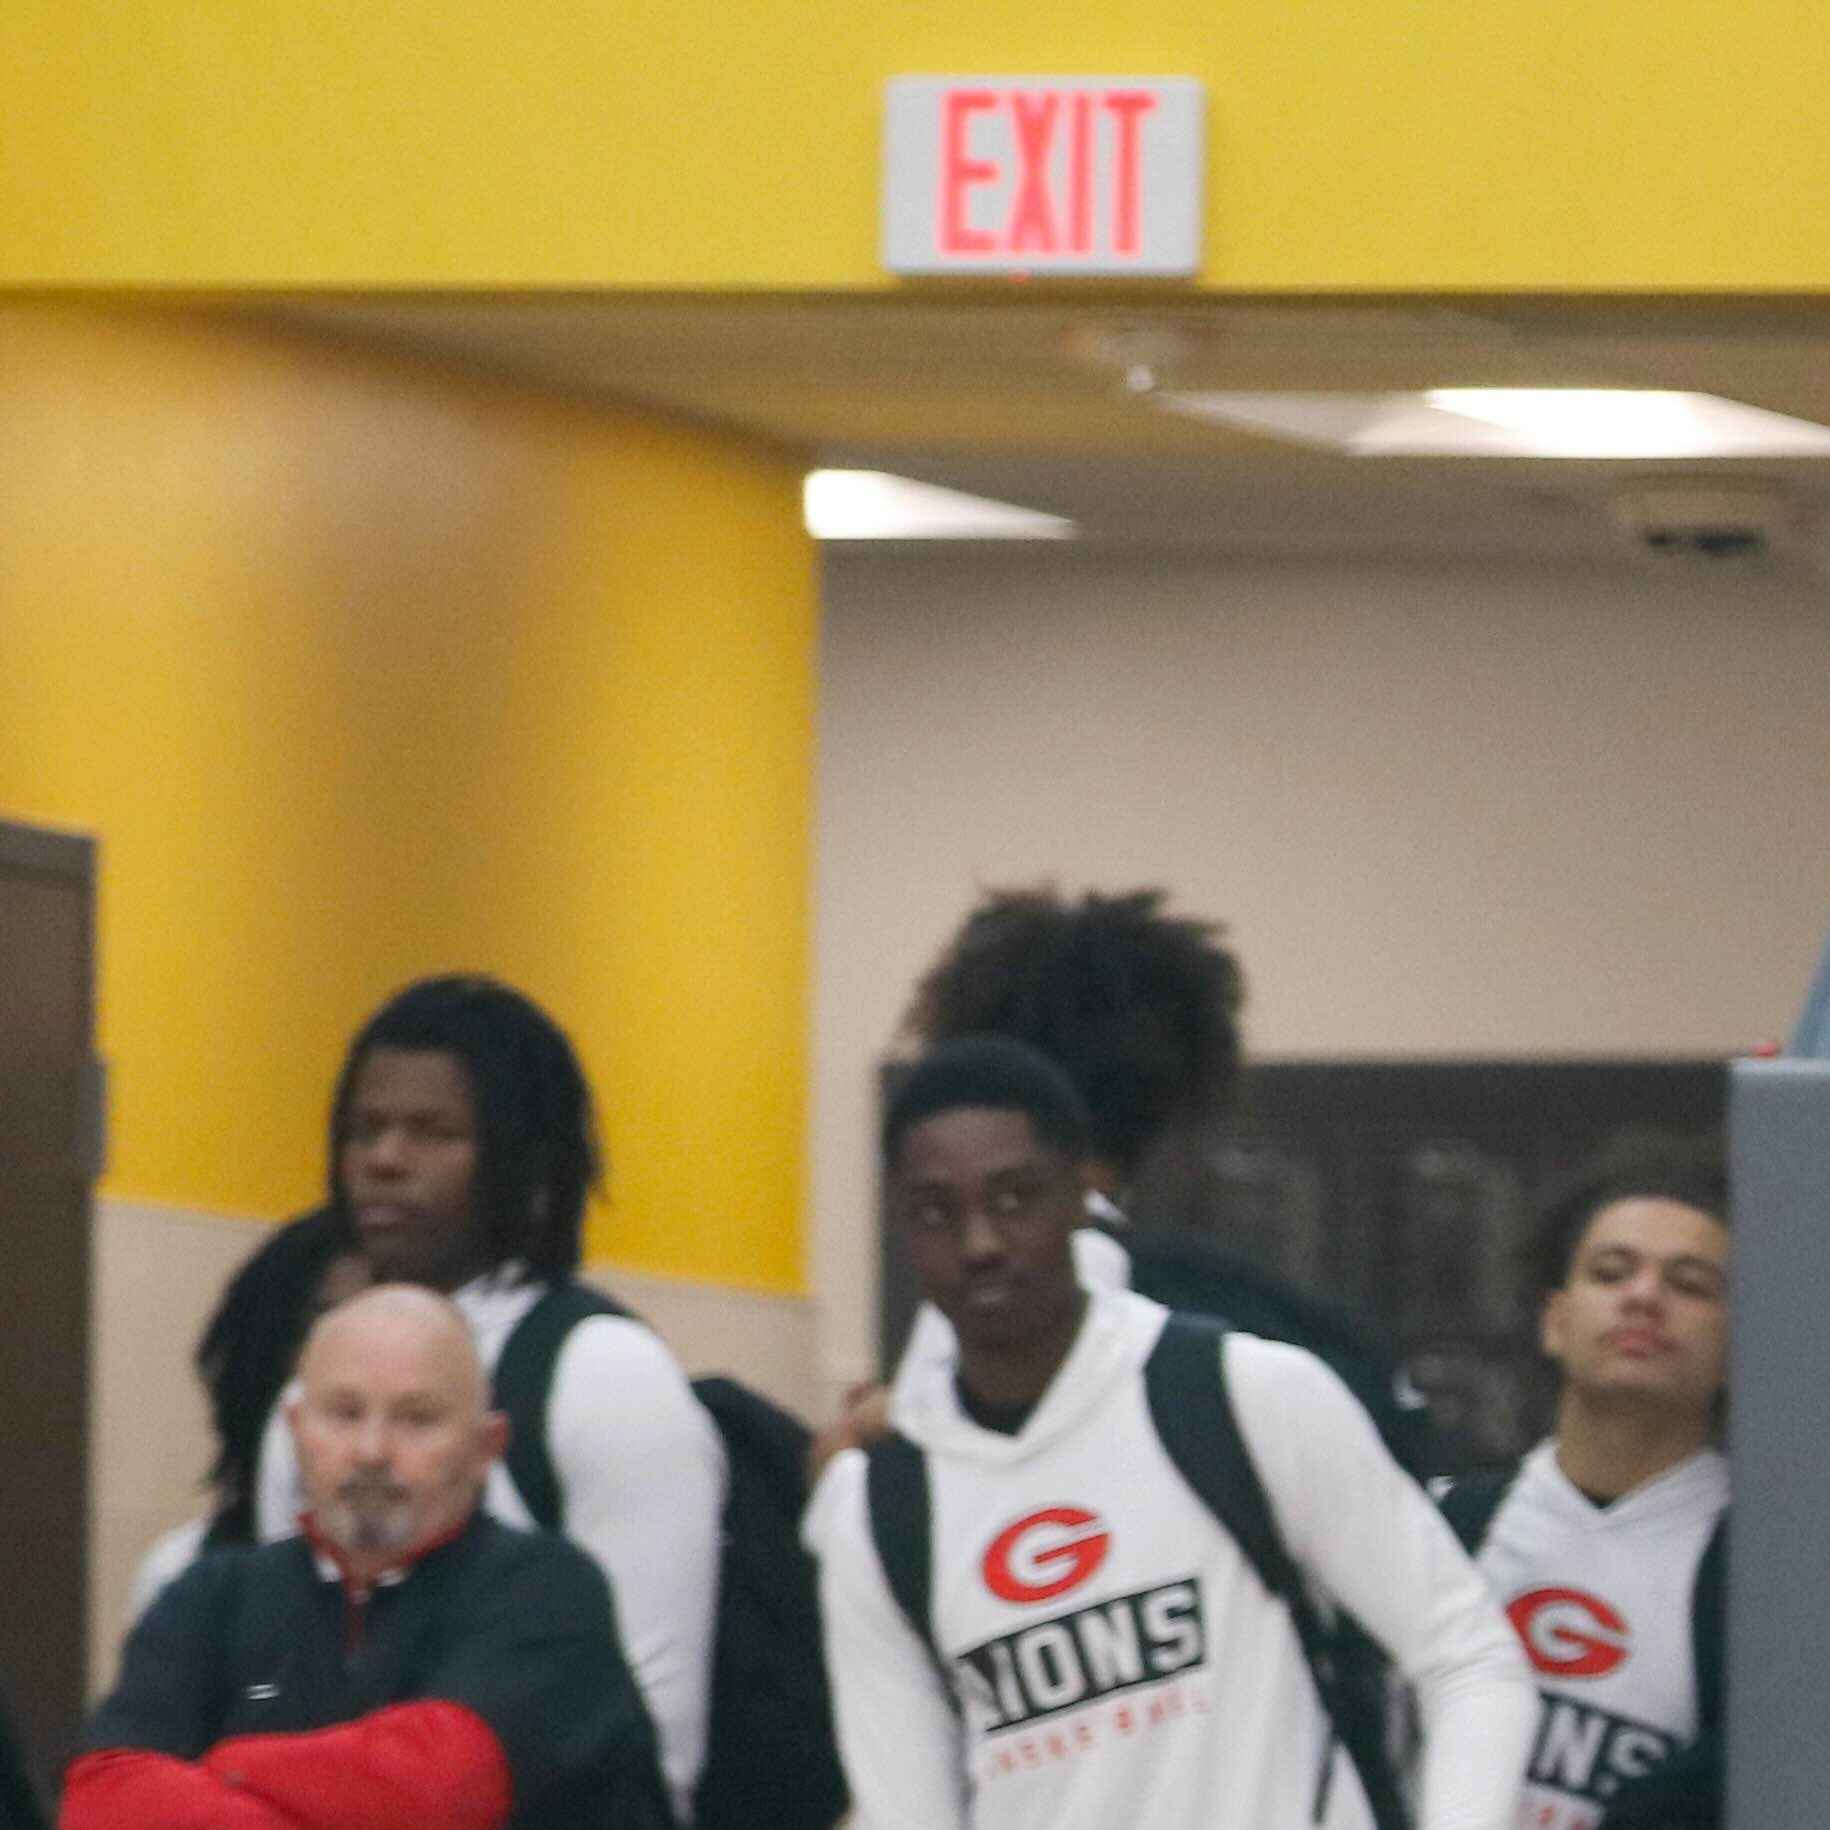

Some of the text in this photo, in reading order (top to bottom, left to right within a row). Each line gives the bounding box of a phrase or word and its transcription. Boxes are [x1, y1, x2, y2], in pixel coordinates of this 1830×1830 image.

[937, 88, 1159, 257] EXIT
[981, 1506, 1110, 1603] G
[1504, 1586, 1629, 1678] G
